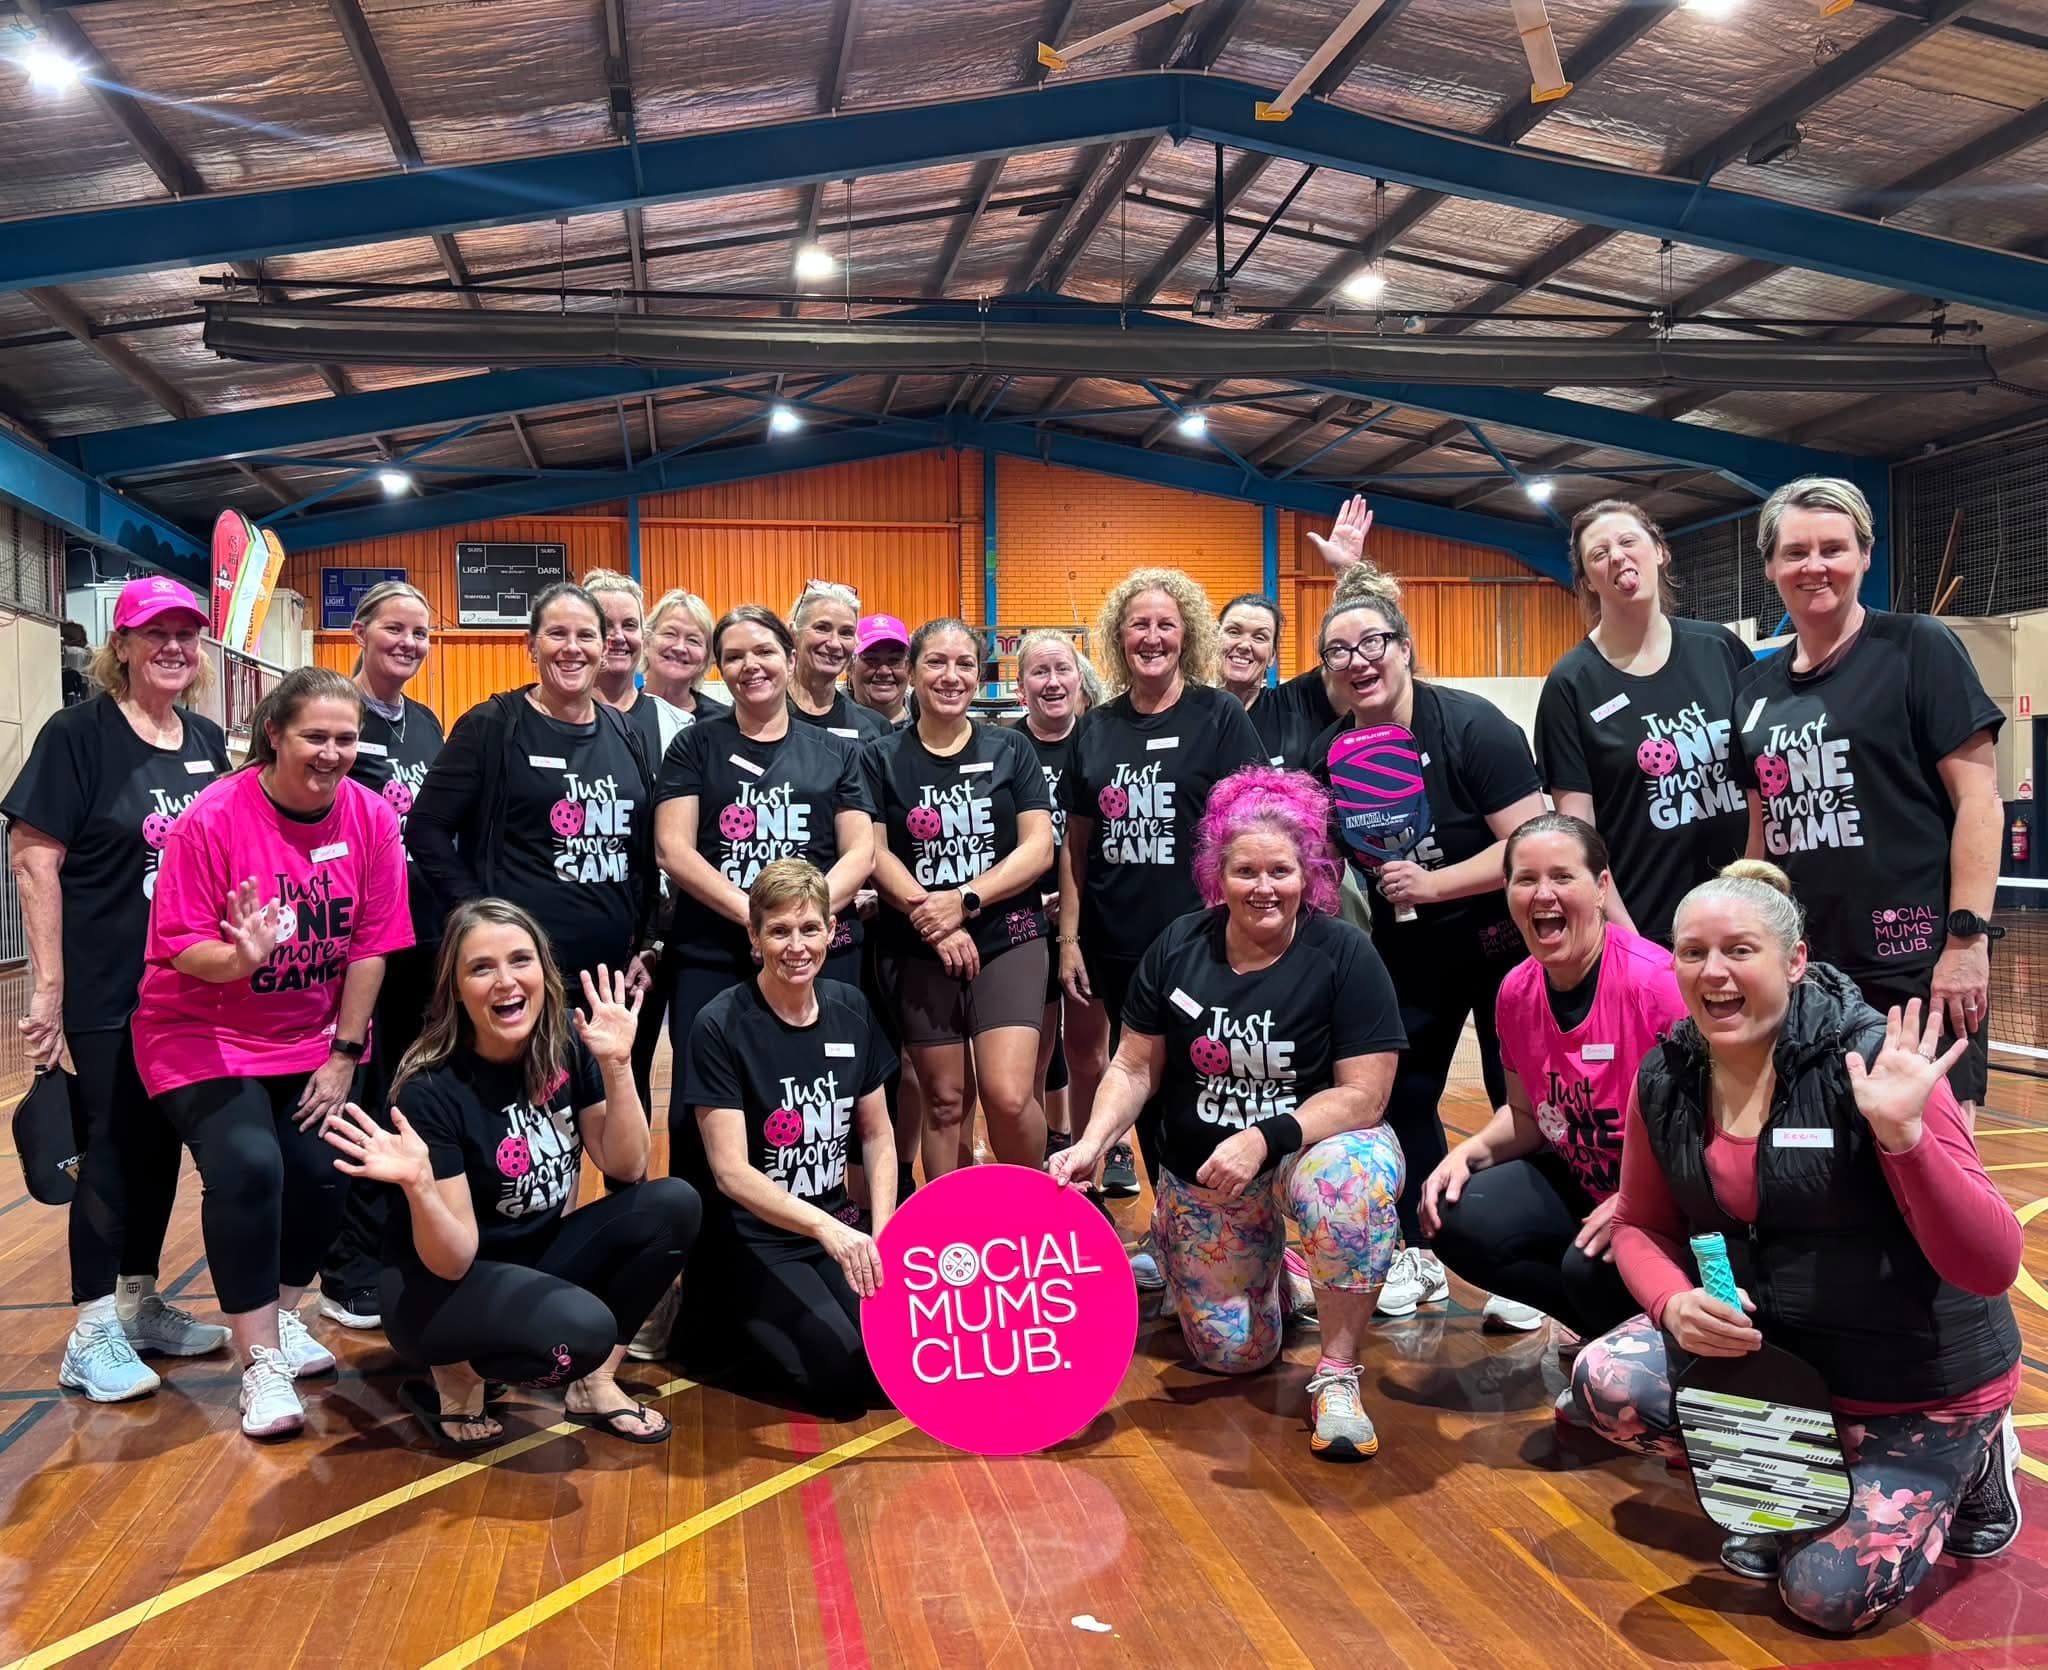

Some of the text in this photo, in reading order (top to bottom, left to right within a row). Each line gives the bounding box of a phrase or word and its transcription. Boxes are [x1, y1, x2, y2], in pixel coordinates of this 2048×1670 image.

[462, 566, 487, 574] LIGHT
[537, 567, 561, 575] DARK
[325, 598, 345, 606] LIGHT
[1641, 701, 1707, 742] Just
[1764, 713, 1828, 758] Just
[563, 773, 619, 803] Just
[1111, 760, 1162, 789] Just
[1659, 762, 1727, 799] more
[736, 780, 794, 808] Just
[919, 779, 975, 809] Just
[1649, 780, 1748, 830] GAME
[1769, 789, 1839, 822] more
[1110, 817, 1161, 838] more
[1765, 810, 1864, 856] GAME
[565, 835, 621, 856] more
[732, 839, 797, 861] more
[924, 834, 984, 859] more
[1102, 837, 1175, 865] GAME
[553, 852, 629, 883] GAME
[275, 869, 333, 907] Just
[1008, 918, 1037, 936] MUMS
[1871, 905, 1939, 924] SOCIAL
[1874, 921, 1933, 940] MUMS
[269, 942, 337, 967] more
[1877, 937, 1932, 956] CLUB.
[250, 958, 343, 994] GAME
[1206, 1006, 1276, 1046] Just
[779, 1070, 839, 1112] Just
[1207, 1074, 1280, 1101] more
[1547, 1071, 1594, 1113] Just
[778, 1140, 840, 1171] more
[515, 1153, 575, 1197] more
[903, 1231, 1102, 1291] SOCIAL
[908, 1278, 1077, 1338] MUMS
[912, 1327, 1072, 1384] CLUB.
